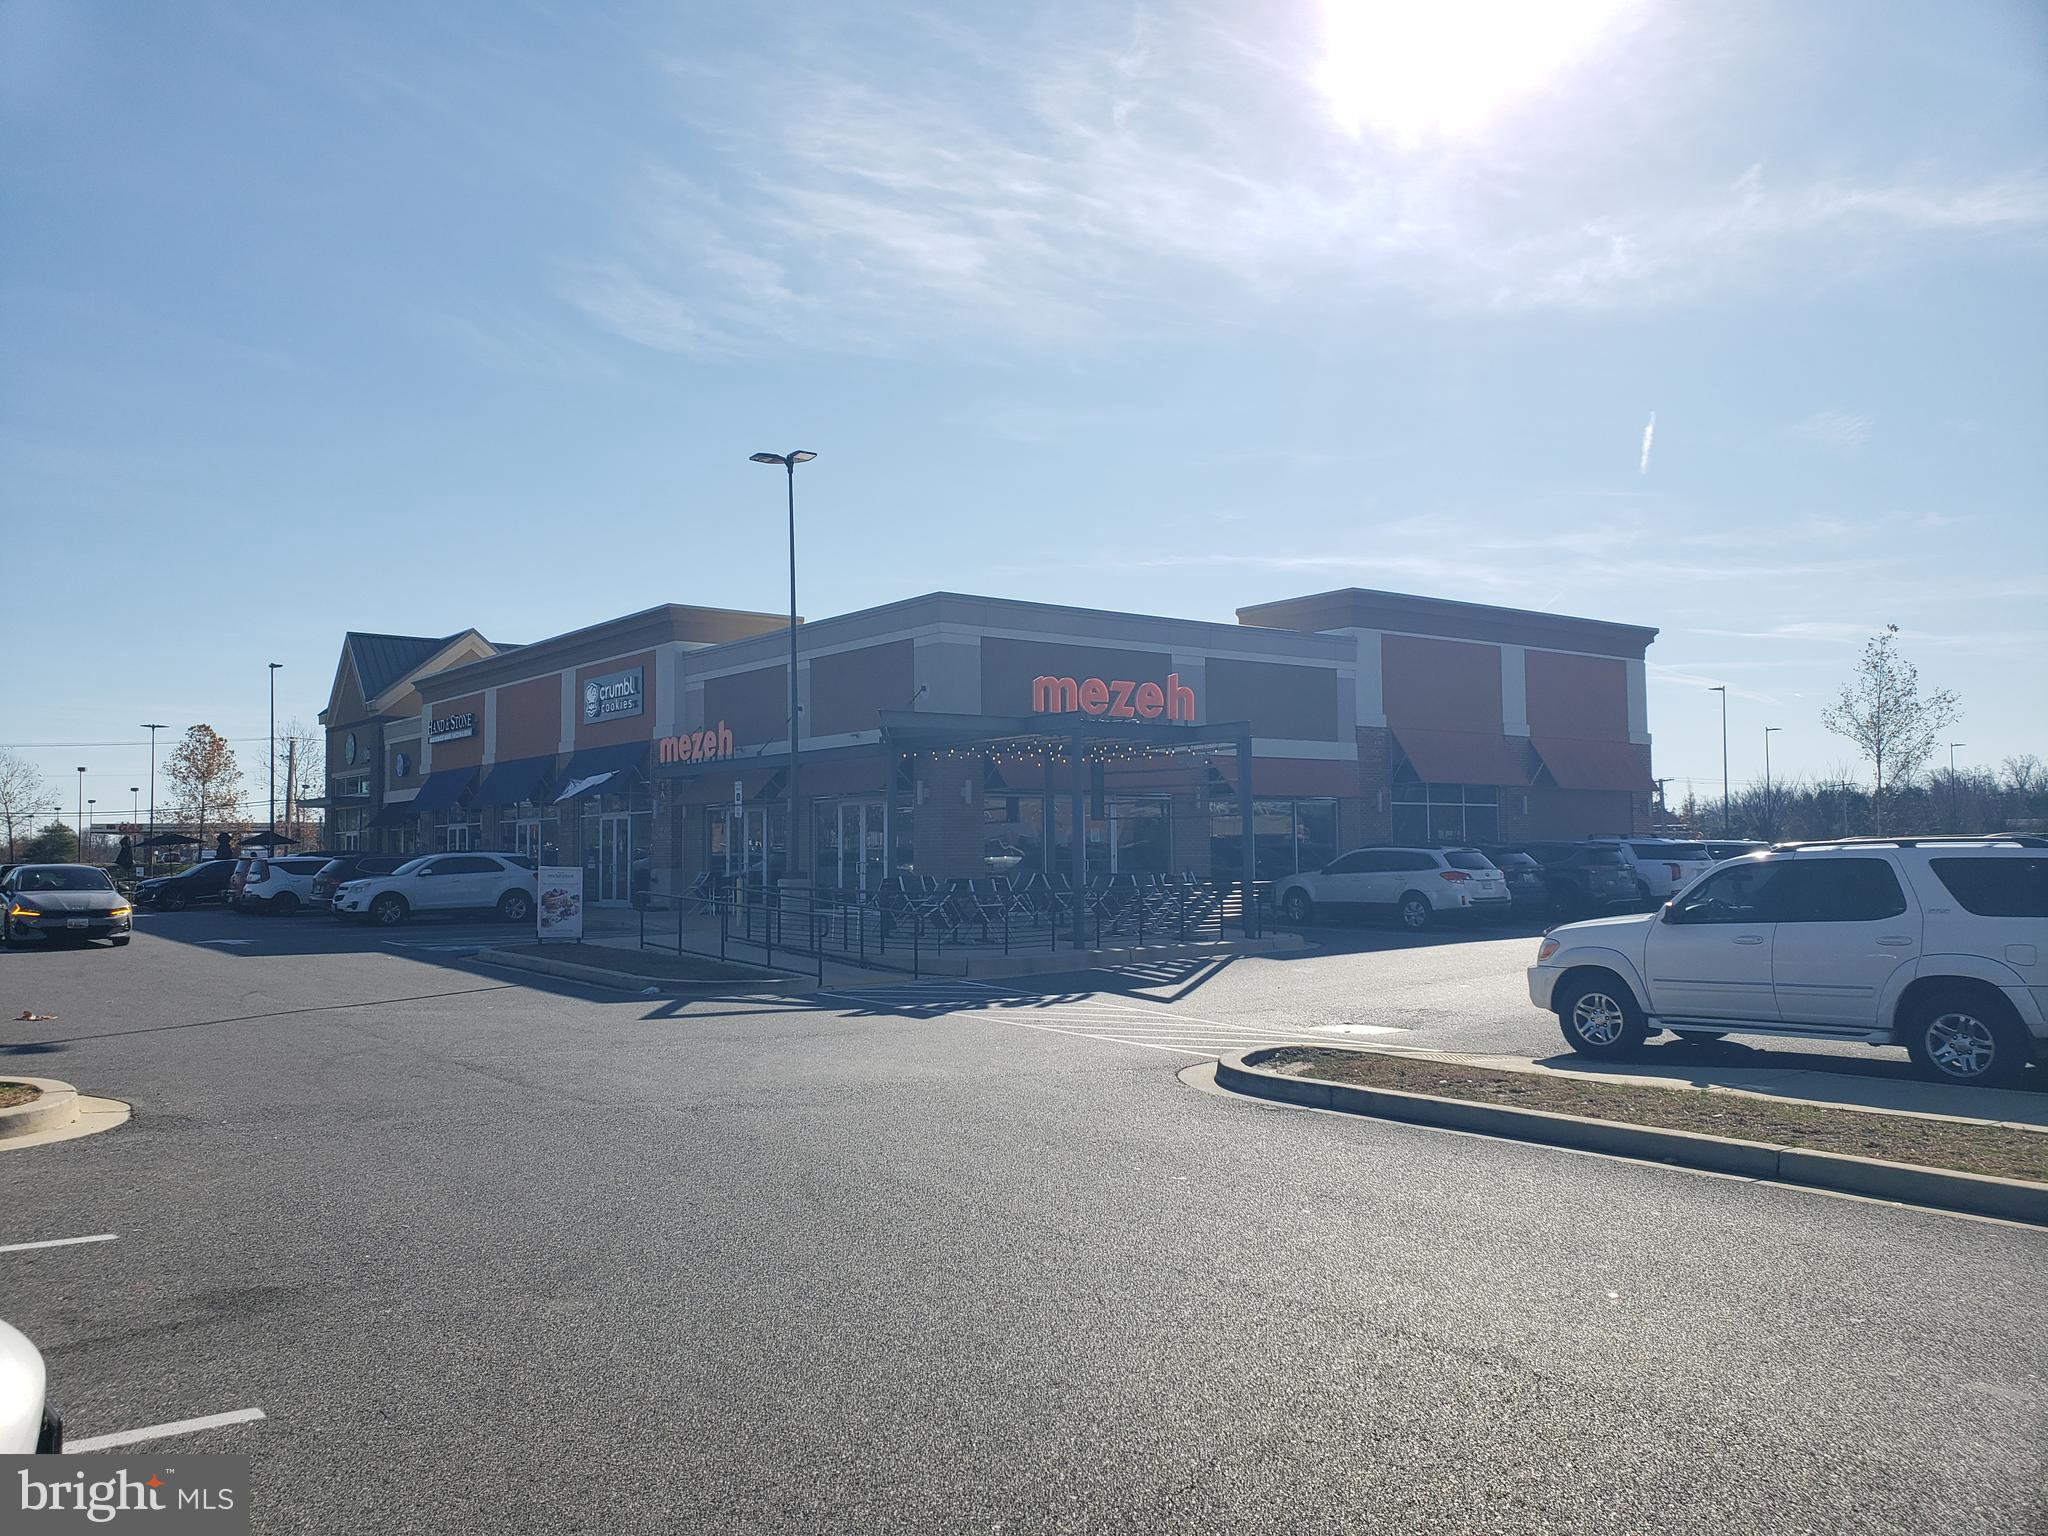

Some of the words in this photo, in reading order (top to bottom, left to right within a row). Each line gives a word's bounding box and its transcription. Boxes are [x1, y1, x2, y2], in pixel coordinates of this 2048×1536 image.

[599, 676, 634, 700] crumbl
[1033, 673, 1195, 721] mezeh
[601, 699, 633, 713] cookies
[428, 719, 445, 735] HAND
[450, 713, 472, 730] STONE
[659, 719, 733, 764] mezeh
